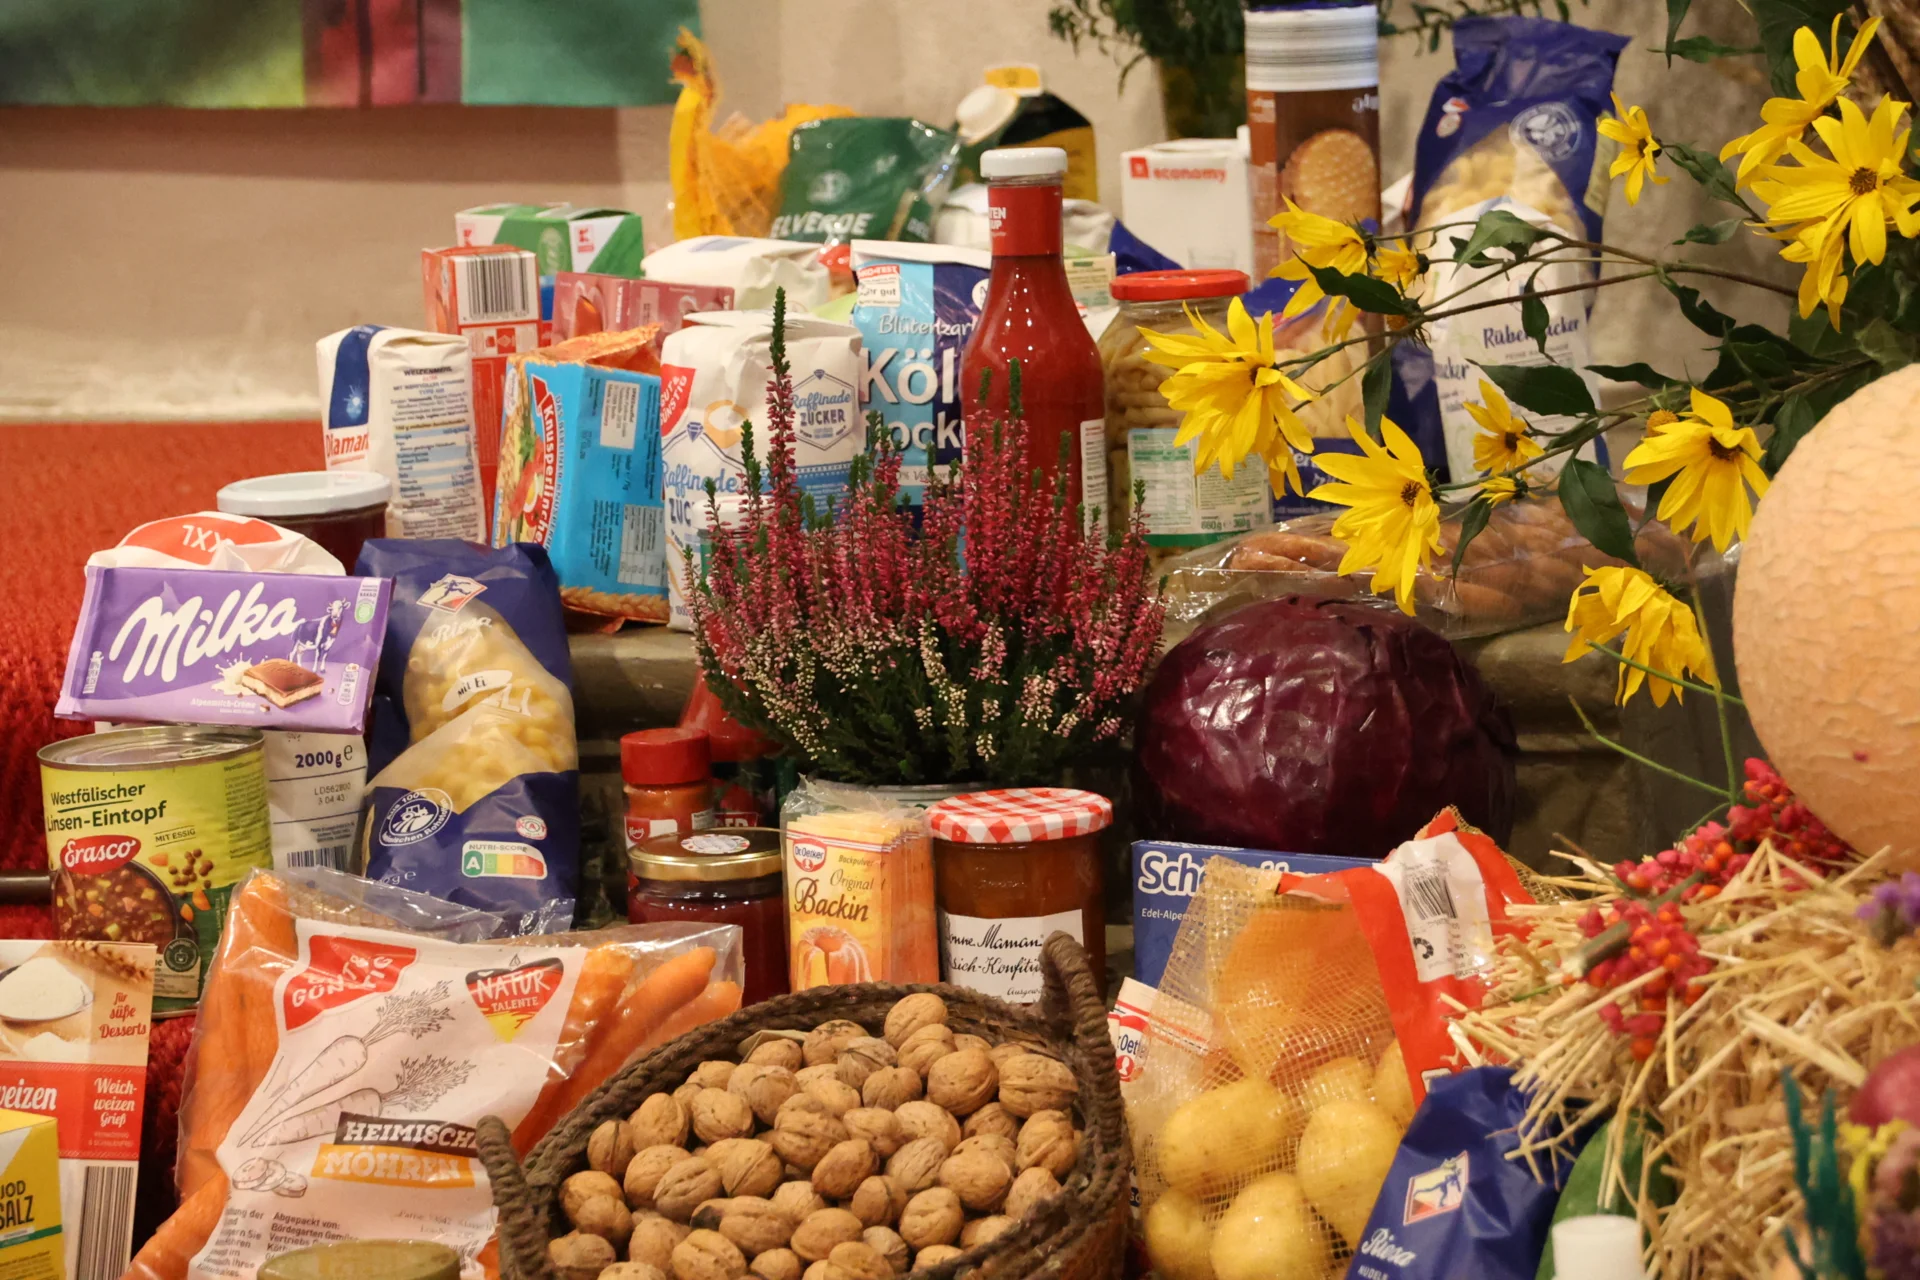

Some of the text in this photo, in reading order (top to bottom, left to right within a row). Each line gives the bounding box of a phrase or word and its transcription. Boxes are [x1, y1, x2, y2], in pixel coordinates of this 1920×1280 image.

[1152, 167, 1227, 184] economy
[989, 207, 1007, 219] TEN
[990, 220, 1003, 230] UP
[879, 314, 976, 336] Blütenzart
[1483, 317, 1580, 349] Rübeucker
[859, 347, 956, 405] Köl
[791, 389, 851, 411] Raffinade
[800, 408, 846, 426] ZUCKER
[325, 430, 369, 459] Diaman
[662, 461, 739, 498] Raffinde
[668, 498, 692, 524] ZUC
[109, 581, 305, 683] Milka
[51, 783, 146, 806] Westfälischer
[155, 828, 196, 843] MIT ESSIG
[64, 839, 137, 867] Erasco
[468, 843, 528, 853] NUTRI-SCORE
[802, 847, 824, 860] Oetker
[466, 856, 481, 870] A
[829, 869, 875, 892] Original
[794, 877, 869, 922] Backin
[977, 923, 1042, 949] Maman
[292, 956, 393, 1007] GÜNTIG
[476, 969, 551, 1004] NATUR
[113, 992, 128, 1005] für
[1007, 988, 1042, 998] Ausgew
[109, 1005, 136, 1020] süße
[491, 996, 538, 1012] TALENTE
[99, 1021, 147, 1039] Desserts
[94, 1077, 137, 1096] Weich-
[94, 1096, 135, 1113] weizen
[100, 1111, 126, 1128] Grieß
[323, 1145, 461, 1182] MÖHREN
[249, 1209, 265, 1220] der
[273, 1211, 320, 1227] Abgepackt
[248, 1229, 262, 1240] Sie
[269, 1232, 310, 1246] Vertriebs
[271, 1222, 323, 1239] Bördegarten
[1361, 1228, 1417, 1268] Riesa
